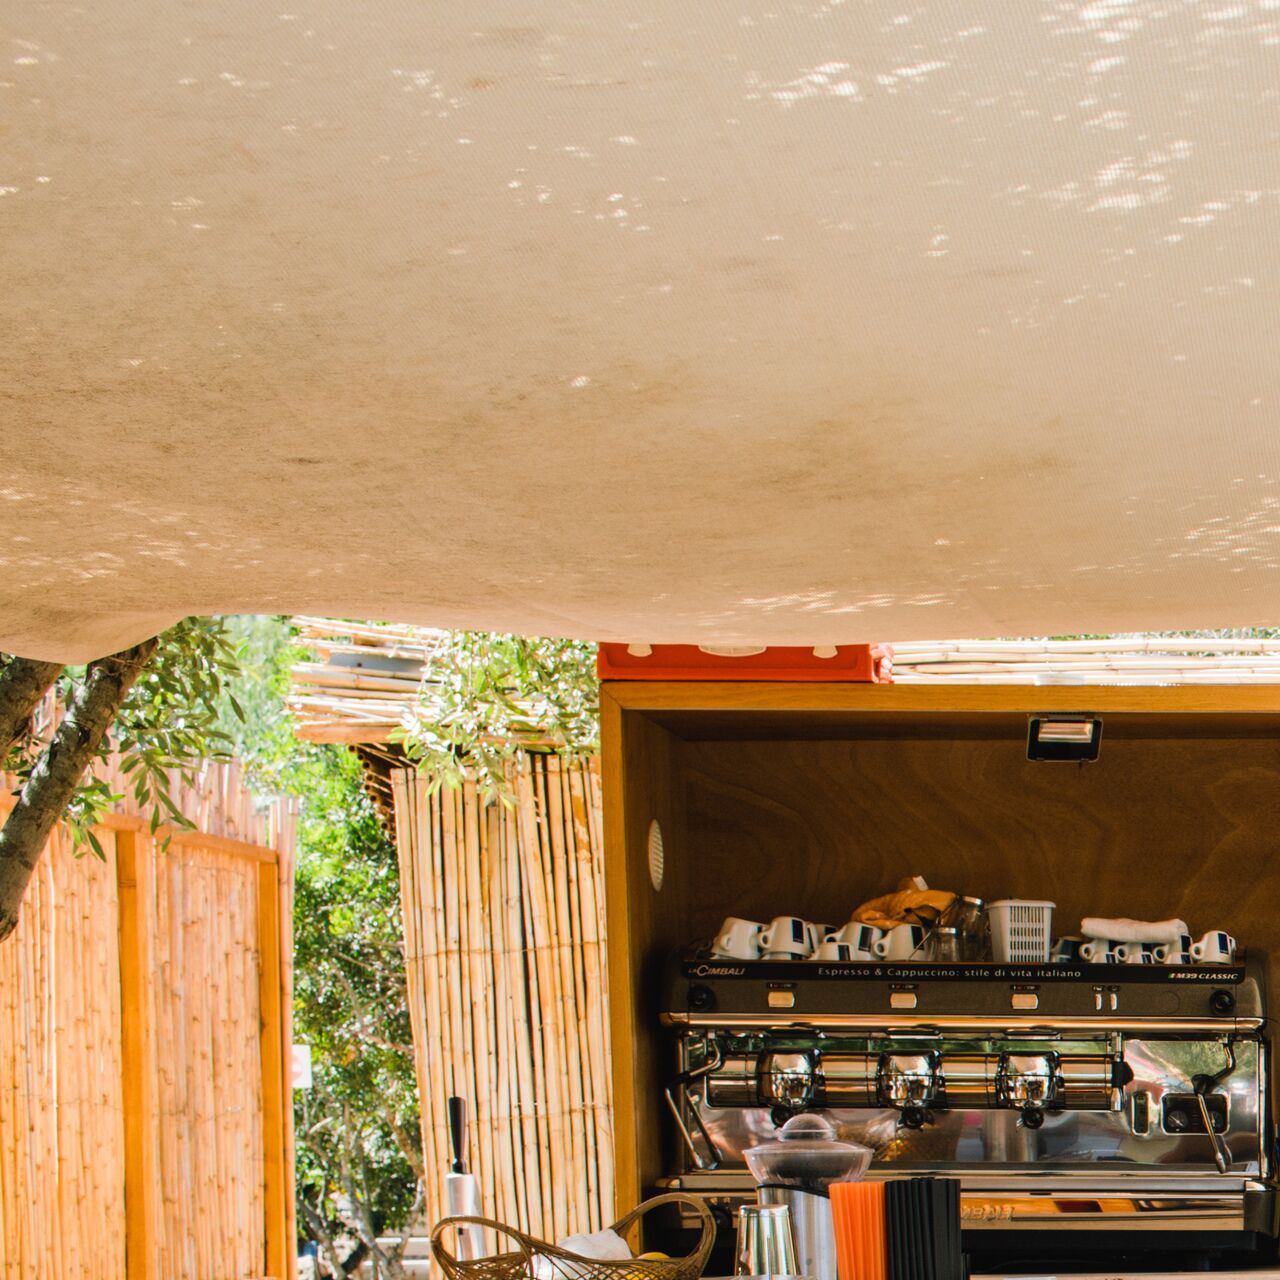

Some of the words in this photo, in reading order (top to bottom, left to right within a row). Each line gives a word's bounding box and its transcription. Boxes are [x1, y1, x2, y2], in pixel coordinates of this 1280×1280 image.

[696, 965, 746, 976] CIMBALI
[818, 967, 870, 977] Espresso
[875, 967, 882, 976] &
[887, 968, 960, 978] Cappuccino:
[965, 969, 990, 977] stile
[995, 969, 1005, 977] di
[1010, 969, 1033, 977] vita
[1037, 969, 1081, 977] italiano
